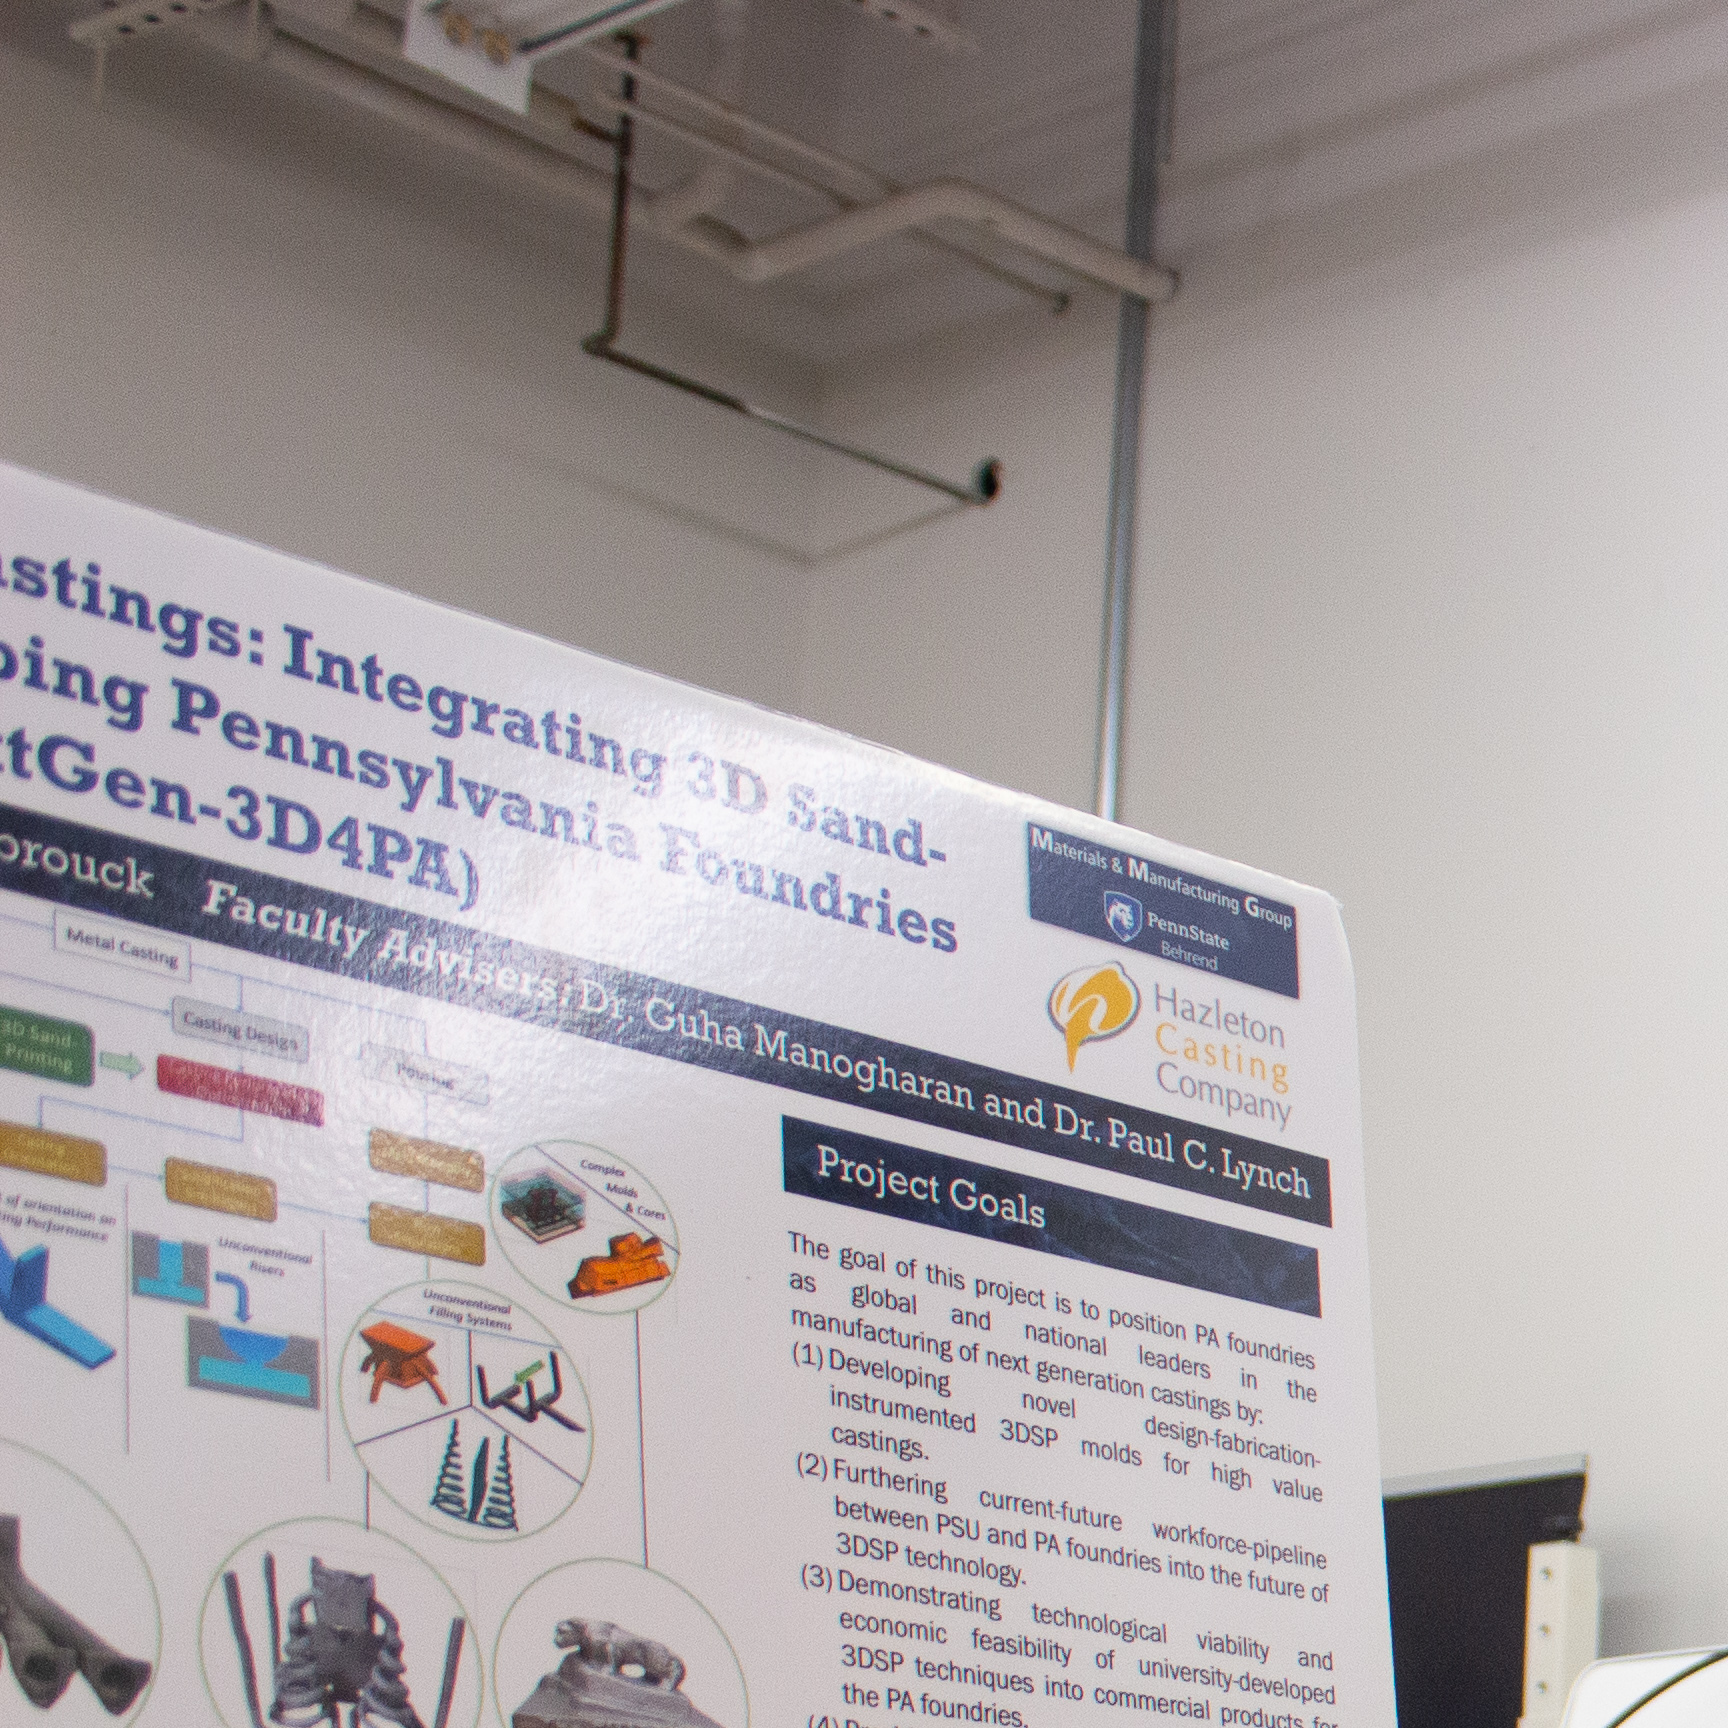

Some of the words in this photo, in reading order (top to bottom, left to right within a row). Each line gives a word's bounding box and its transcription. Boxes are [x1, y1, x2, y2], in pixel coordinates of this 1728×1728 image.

[285, 625, 668, 798] Integrating
[689, 752, 769, 814] 3D
[787, 783, 947, 868] Sand-
[0, 730, 480, 913] tGen-3D4PA)
[173, 679, 641, 863] Pennsylvania
[661, 824, 958, 955] Foundries
[1034, 828, 1108, 871] Materials
[1113, 859, 1123, 875] &
[1130, 859, 1240, 916] Manufacturing
[1246, 895, 1293, 931] Group
[66, 924, 116, 951] Metal
[119, 939, 180, 970] Casting
[1149, 913, 1230, 951] PennState
[1163, 942, 1219, 972] Behrend
[204, 880, 369, 961] Faculty
[375, 929, 571, 1005] Advisers:
[580, 978, 634, 1022] Dr.
[644, 996, 744, 1052] Guha
[755, 1024, 975, 1112] Manogharan
[985, 1094, 1046, 1131] and
[1055, 1104, 1101, 1145] Dr.
[1109, 1118, 1175, 1164] Paul
[1185, 1140, 1215, 1174] C.
[1223, 1149, 1311, 1201] Lynch
[1156, 985, 1285, 1050] Hazleton
[1156, 1022, 1289, 1096] Casting
[1158, 1061, 1292, 1133] Company
[580, 1158, 627, 1179] Complex
[605, 1181, 639, 1199] Molds
[819, 1145, 940, 1205] Project
[951, 1179, 1046, 1230] Goals
[790, 1232, 830, 1262] The
[841, 1249, 886, 1274] goal
[897, 1259, 916, 1279] of
[927, 1266, 966, 1292] this
[976, 1279, 1046, 1311] project
[1057, 1298, 1072, 1316] is
[1081, 1300, 1100, 1322] to
[1110, 1310, 1187, 1341] position
[1197, 1325, 1220, 1349] PA
[1228, 1333, 1316, 1372] foundries
[791, 1273, 817, 1295] as
[853, 1286, 917, 1316] global
[952, 1309, 991, 1333] and
[1026, 1325, 1107, 1357] national
[1140, 1347, 1212, 1381] leaders
[1242, 1374, 1258, 1391] in
[1288, 1381, 1315, 1404] the
[793, 1310, 954, 1364] manufacturing
[960, 1344, 979, 1364] of
[988, 1351, 1030, 1376] next
[1038, 1362, 1145, 1399] generation
[1152, 1387, 1232, 1422] castings
[1238, 1402, 1261, 1428] by:
[794, 1343, 824, 1370] (1)
[831, 1349, 952, 1399] Developing
[1023, 1394, 1076, 1420] novel
[1145, 1417, 1320, 1469] design-fabrication-
[832, 1427, 929, 1463] castings.
[832, 1391, 977, 1435] instrumented
[1002, 1419, 1059, 1449] 3DSP
[1082, 1441, 1143, 1468] molds
[1165, 1453, 1190, 1476] for
[1213, 1463, 1252, 1493] high
[1274, 1480, 1323, 1504] value
